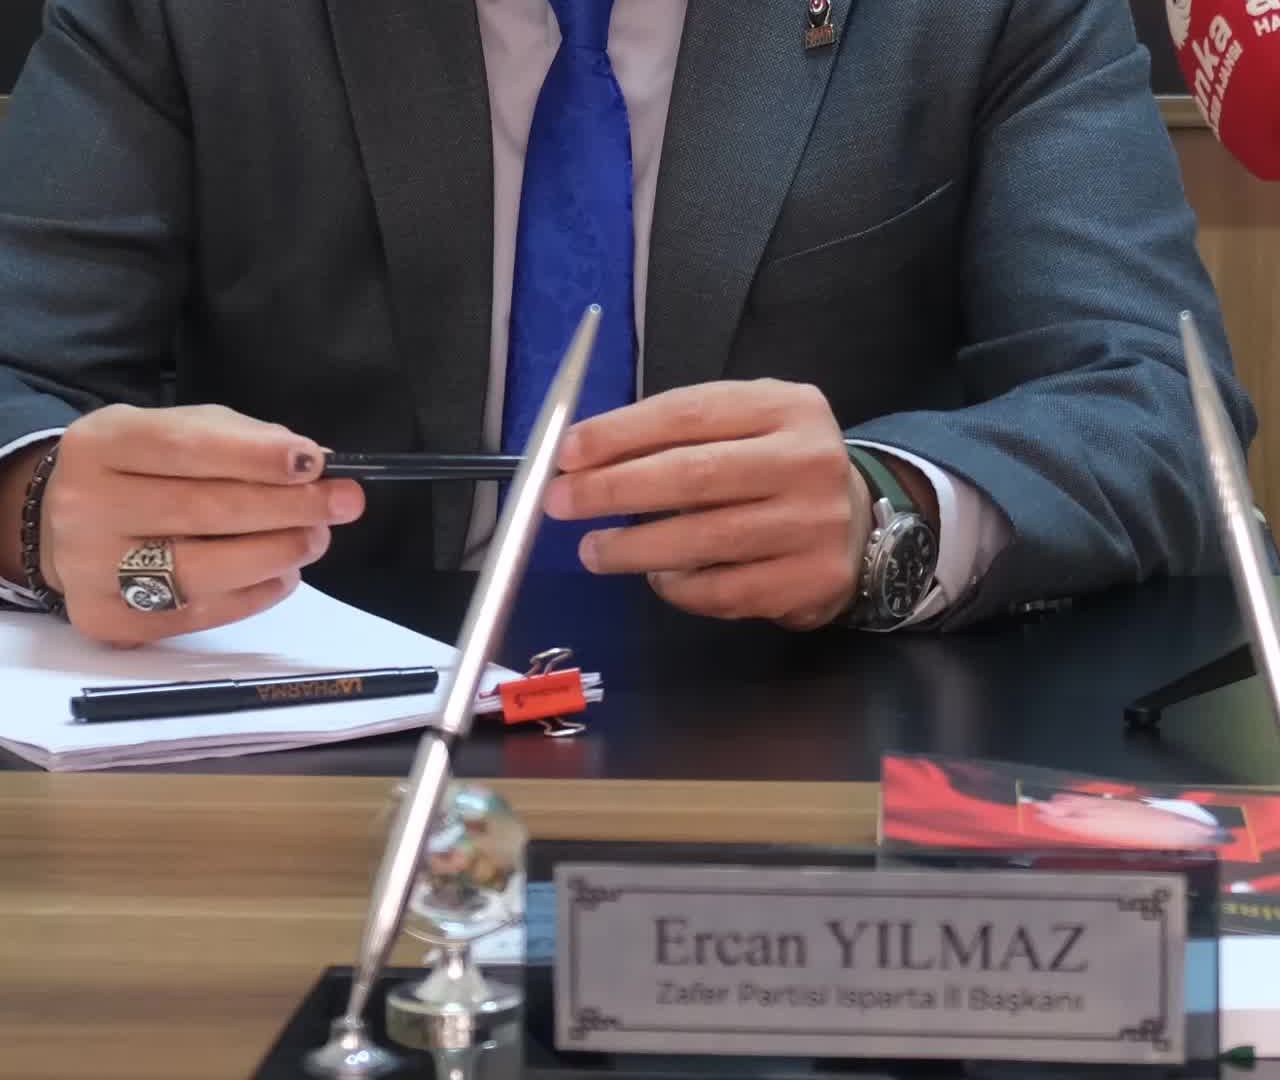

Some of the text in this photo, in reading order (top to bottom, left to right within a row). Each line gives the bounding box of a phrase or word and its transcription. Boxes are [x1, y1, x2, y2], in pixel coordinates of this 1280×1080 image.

[654, 918, 1089, 973] Ercan YILMAZ
[655, 980, 729, 1006] Zafer
